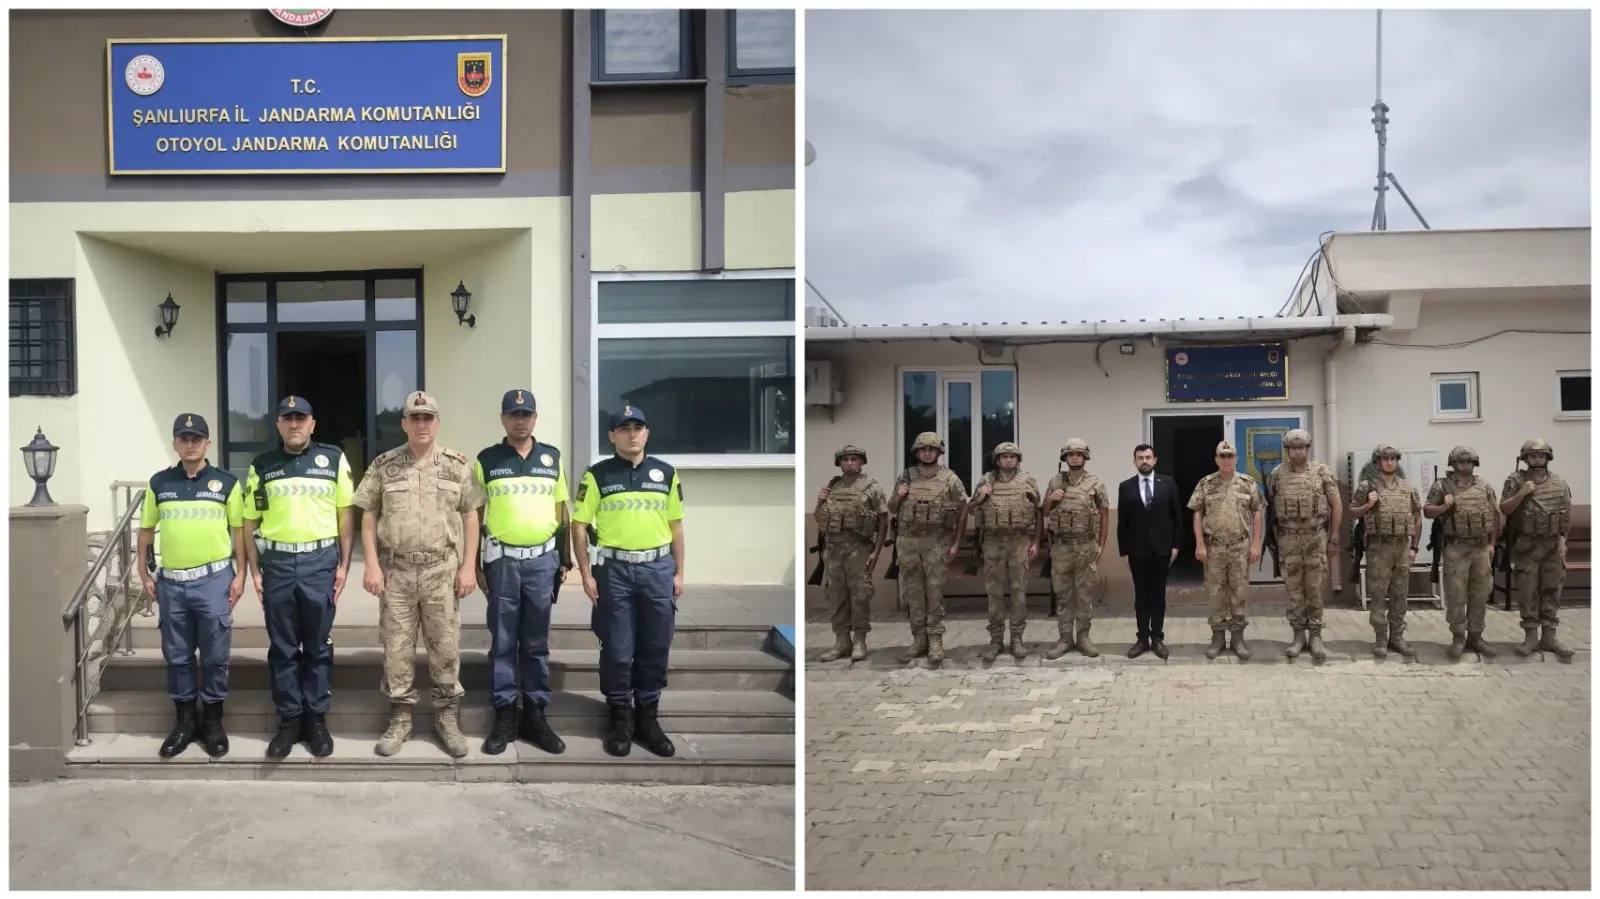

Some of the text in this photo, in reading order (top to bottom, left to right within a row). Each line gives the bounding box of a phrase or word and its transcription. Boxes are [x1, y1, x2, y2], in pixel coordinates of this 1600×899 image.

[291, 79, 321, 94] T.C.
[132, 103, 480, 126] ŞANLIURFA İL JANDARMA KOMUTANLIĞI
[156, 132, 457, 152] OTOYOL JANDARMA KOMUTANLIĞI
[490, 467, 514, 477] OTOYOL
[601, 484, 626, 494] OTOYOL
